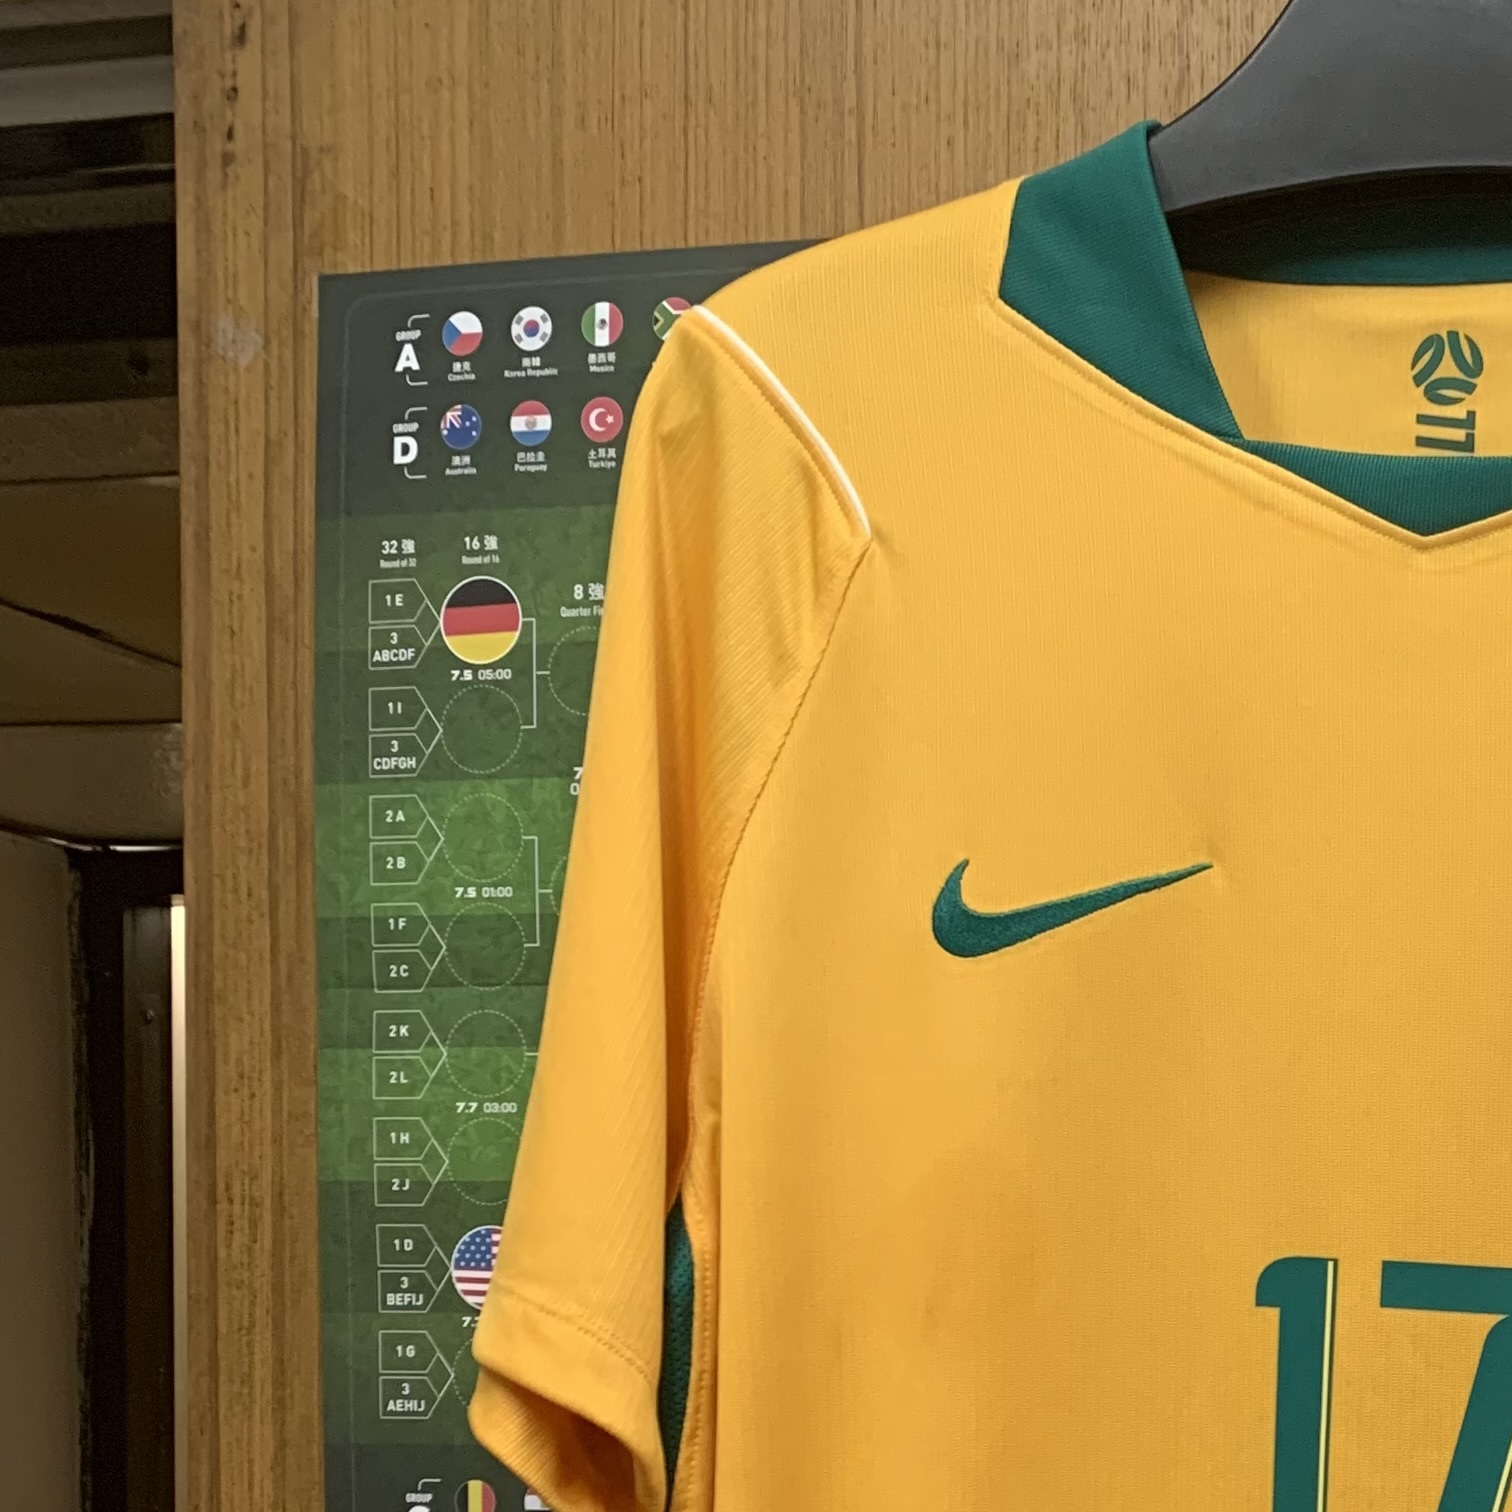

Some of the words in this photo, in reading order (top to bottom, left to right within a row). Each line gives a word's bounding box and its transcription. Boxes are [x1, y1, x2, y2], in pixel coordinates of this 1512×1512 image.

[395, 329, 421, 341] GROUP
[394, 343, 420, 372] A
[392, 422, 419, 434] GROUP
[393, 436, 418, 465] D
[588, 448, 616, 459] 土耳其
[516, 451, 545, 463] 巴拉圭
[381, 540, 398, 554] 32
[401, 538, 415, 554] 強
[464, 536, 480, 550] 16
[484, 535, 498, 550] 強
[574, 584, 583, 600] 8
[560, 606, 591, 618] Quarter
[390, 632, 398, 645] 3
[372, 649, 416, 662] ABCDF
[450, 670, 473, 681] 7.5
[477, 669, 512, 680] 05:00
[390, 740, 398, 752] 3
[373, 756, 416, 770] CDFGH
[454, 887, 477, 898] 7.5
[481, 886, 513, 898] 01:00
[455, 1102, 478, 1113] 7.7
[483, 1102, 517, 1113] 03:00
[400, 1277, 408, 1289] 3
[386, 1293, 423, 1306] BEFIJ
[401, 1383, 410, 1395] 3
[387, 1400, 425, 1412] AEHIJ
